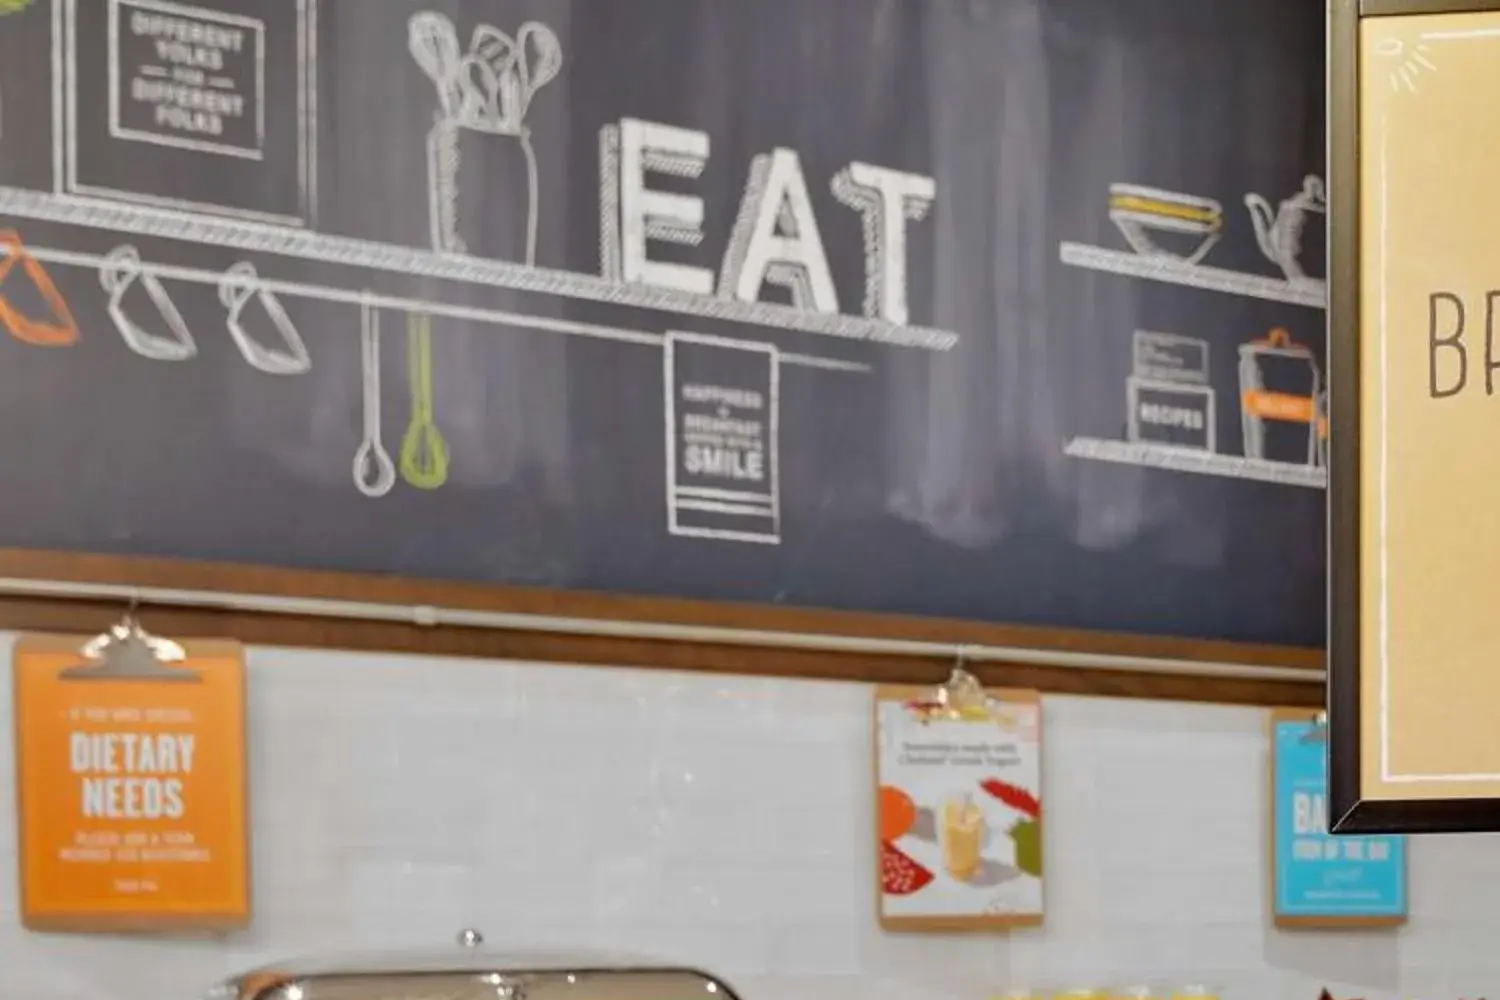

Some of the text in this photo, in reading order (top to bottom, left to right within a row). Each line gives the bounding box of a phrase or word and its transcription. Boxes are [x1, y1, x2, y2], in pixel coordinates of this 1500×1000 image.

[600, 117, 936, 325] EAT
[684, 446, 763, 481] SMILE
[69, 730, 195, 774] DIETARY
[81, 775, 185, 820] NEEDS
